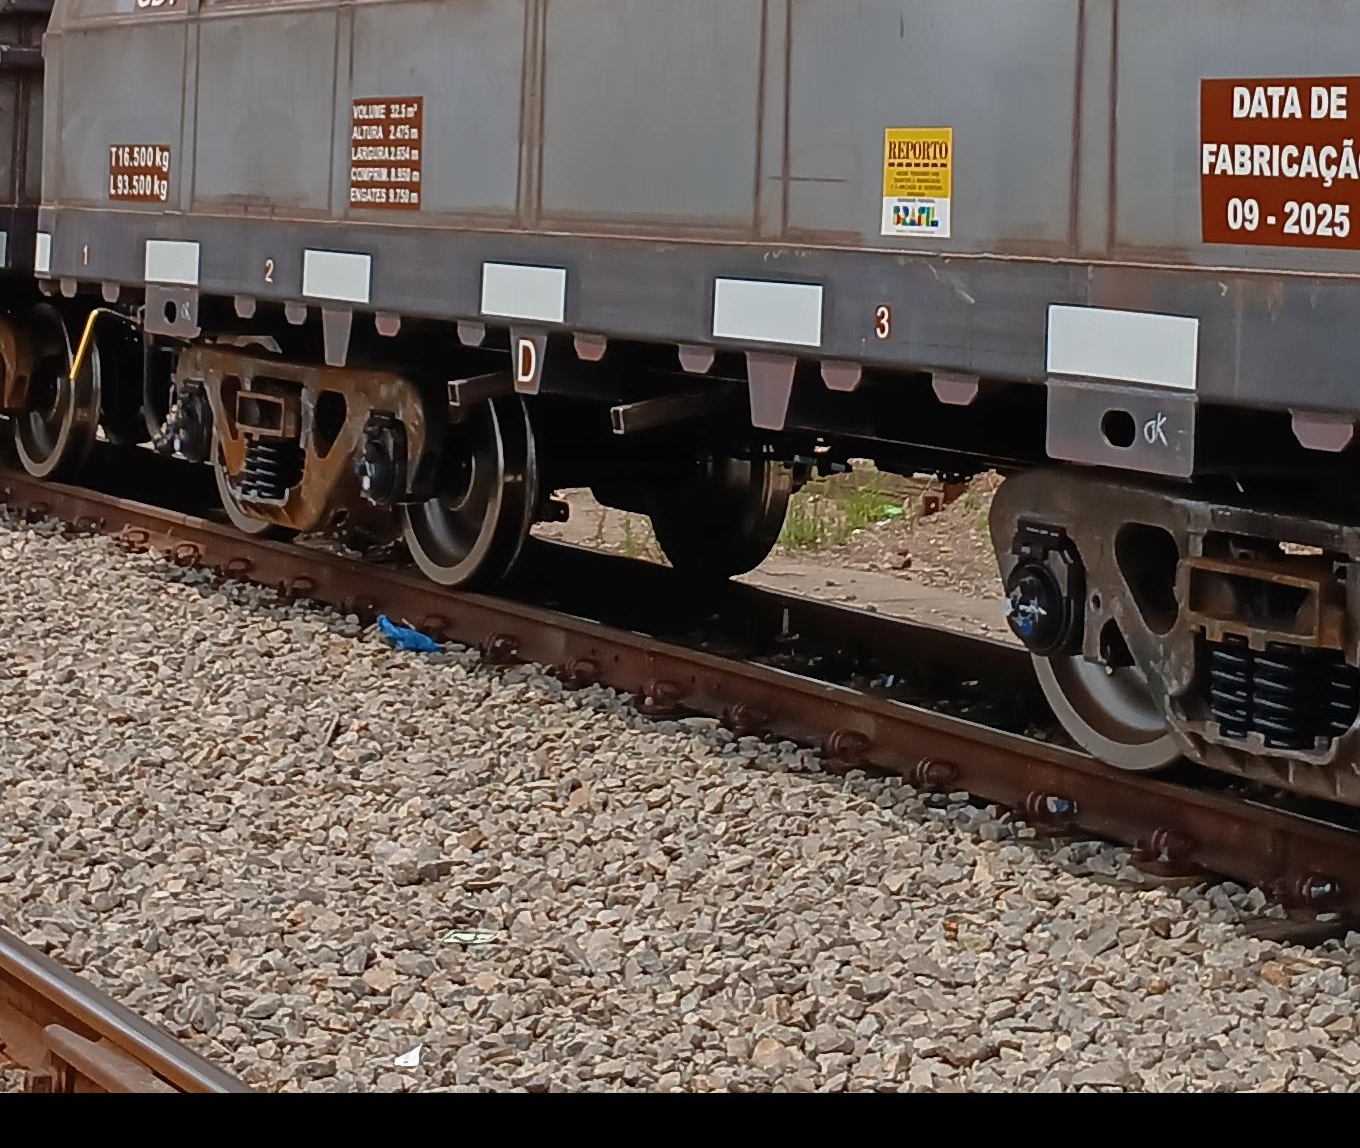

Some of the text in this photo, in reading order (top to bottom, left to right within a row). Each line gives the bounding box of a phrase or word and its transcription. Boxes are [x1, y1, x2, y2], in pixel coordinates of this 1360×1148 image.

[352, 104, 386, 119] VOLUME
[1232, 86, 1348, 119] DATA DE
[352, 124, 384, 140] ALTURA
[410, 128, 419, 139] m
[155, 146, 170, 172] kg
[351, 146, 389, 161] LARGURA
[411, 149, 419, 160] m
[887, 140, 949, 161] REPORTO
[153, 174, 168, 201] kg
[350, 187, 387, 202] ENGATES
[410, 192, 419, 203] m
[1227, 197, 1351, 238] 09 - 2025
[83, 244, 89, 267] 1
[263, 258, 275, 284] 2
[875, 305, 890, 340] 3
[517, 339, 536, 383] D
[1143, 411, 1169, 447] OK
